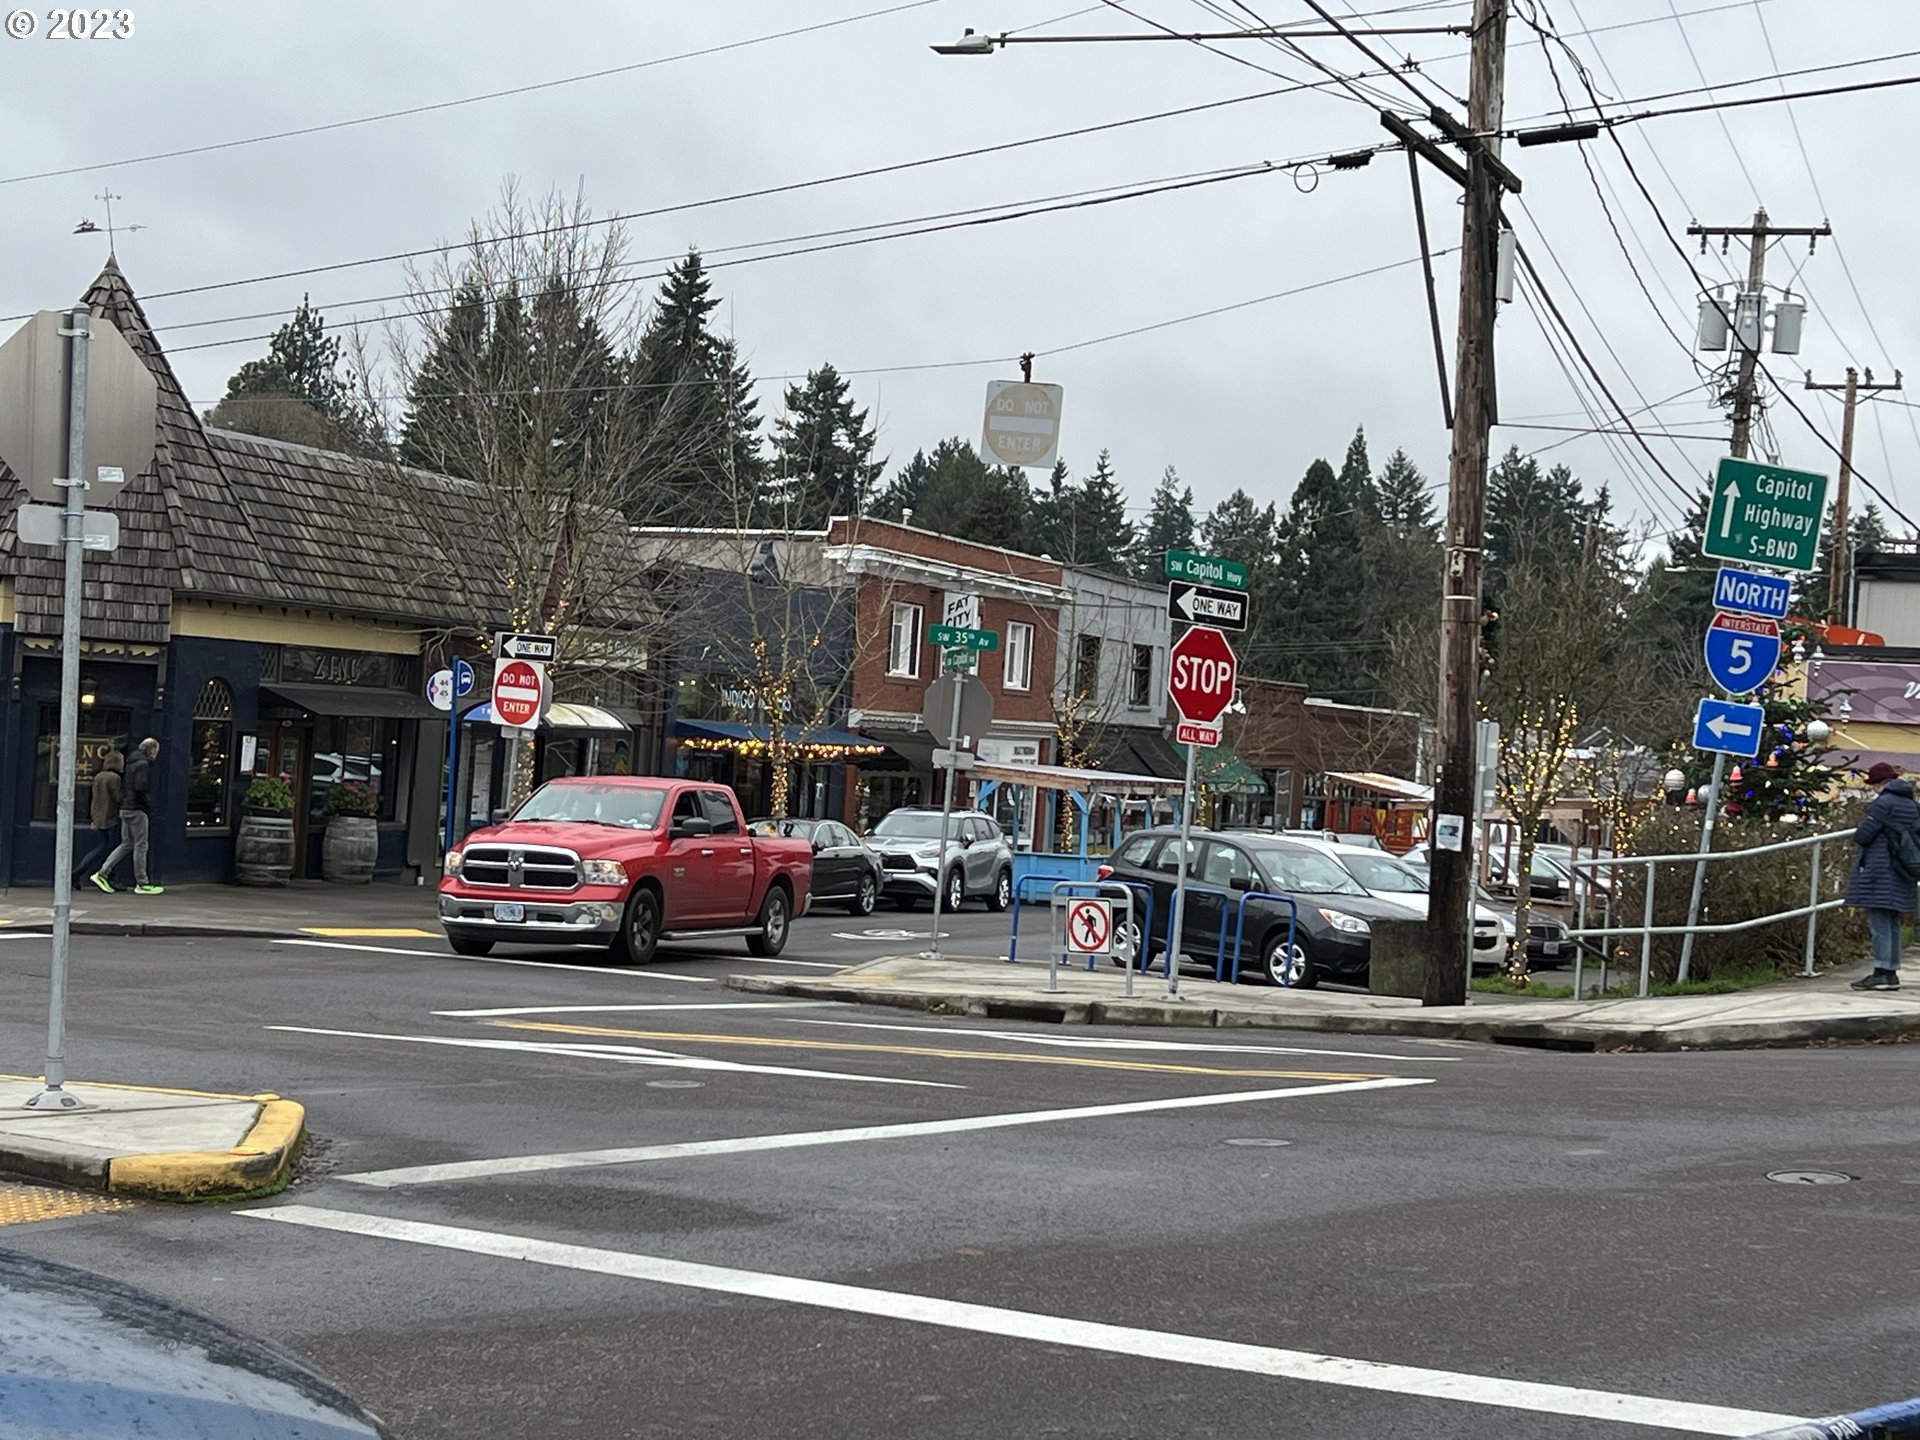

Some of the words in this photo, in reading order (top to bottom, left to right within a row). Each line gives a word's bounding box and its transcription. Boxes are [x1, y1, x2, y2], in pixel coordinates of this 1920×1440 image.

[996, 399, 1014, 411] DO
[1025, 401, 1049, 415] NOT
[998, 436, 1041, 452] ENTER
[1756, 474, 1813, 501] Capitol
[1744, 503, 1814, 537] Highway
[1748, 535, 1798, 560] S-BND
[1171, 560, 1183, 571] SW
[1186, 559, 1223, 580] Capitol
[1226, 571, 1242, 586] Hwy
[1720, 575, 1785, 611] NORTH
[947, 596, 969, 615] FAT
[1192, 597, 1214, 614] ONE
[1217, 601, 1238, 618] WAY
[945, 609, 972, 628] CITY
[1721, 618, 1771, 634] INTERSTATE
[517, 642, 531, 653] ONE
[534, 643, 550, 653] WAY
[938, 632, 950, 641] SW
[955, 631, 975, 644] 35th
[978, 637, 989, 646] Av
[1727, 638, 1754, 675] 5
[502, 672, 515, 683] DO
[519, 674, 535, 686] NOT
[1173, 654, 1231, 695] STOP
[503, 701, 530, 714] ENTER
[721, 688, 756, 709] INDIGO
[1181, 728, 1196, 740] ALL
[1199, 730, 1215, 743] WAY
